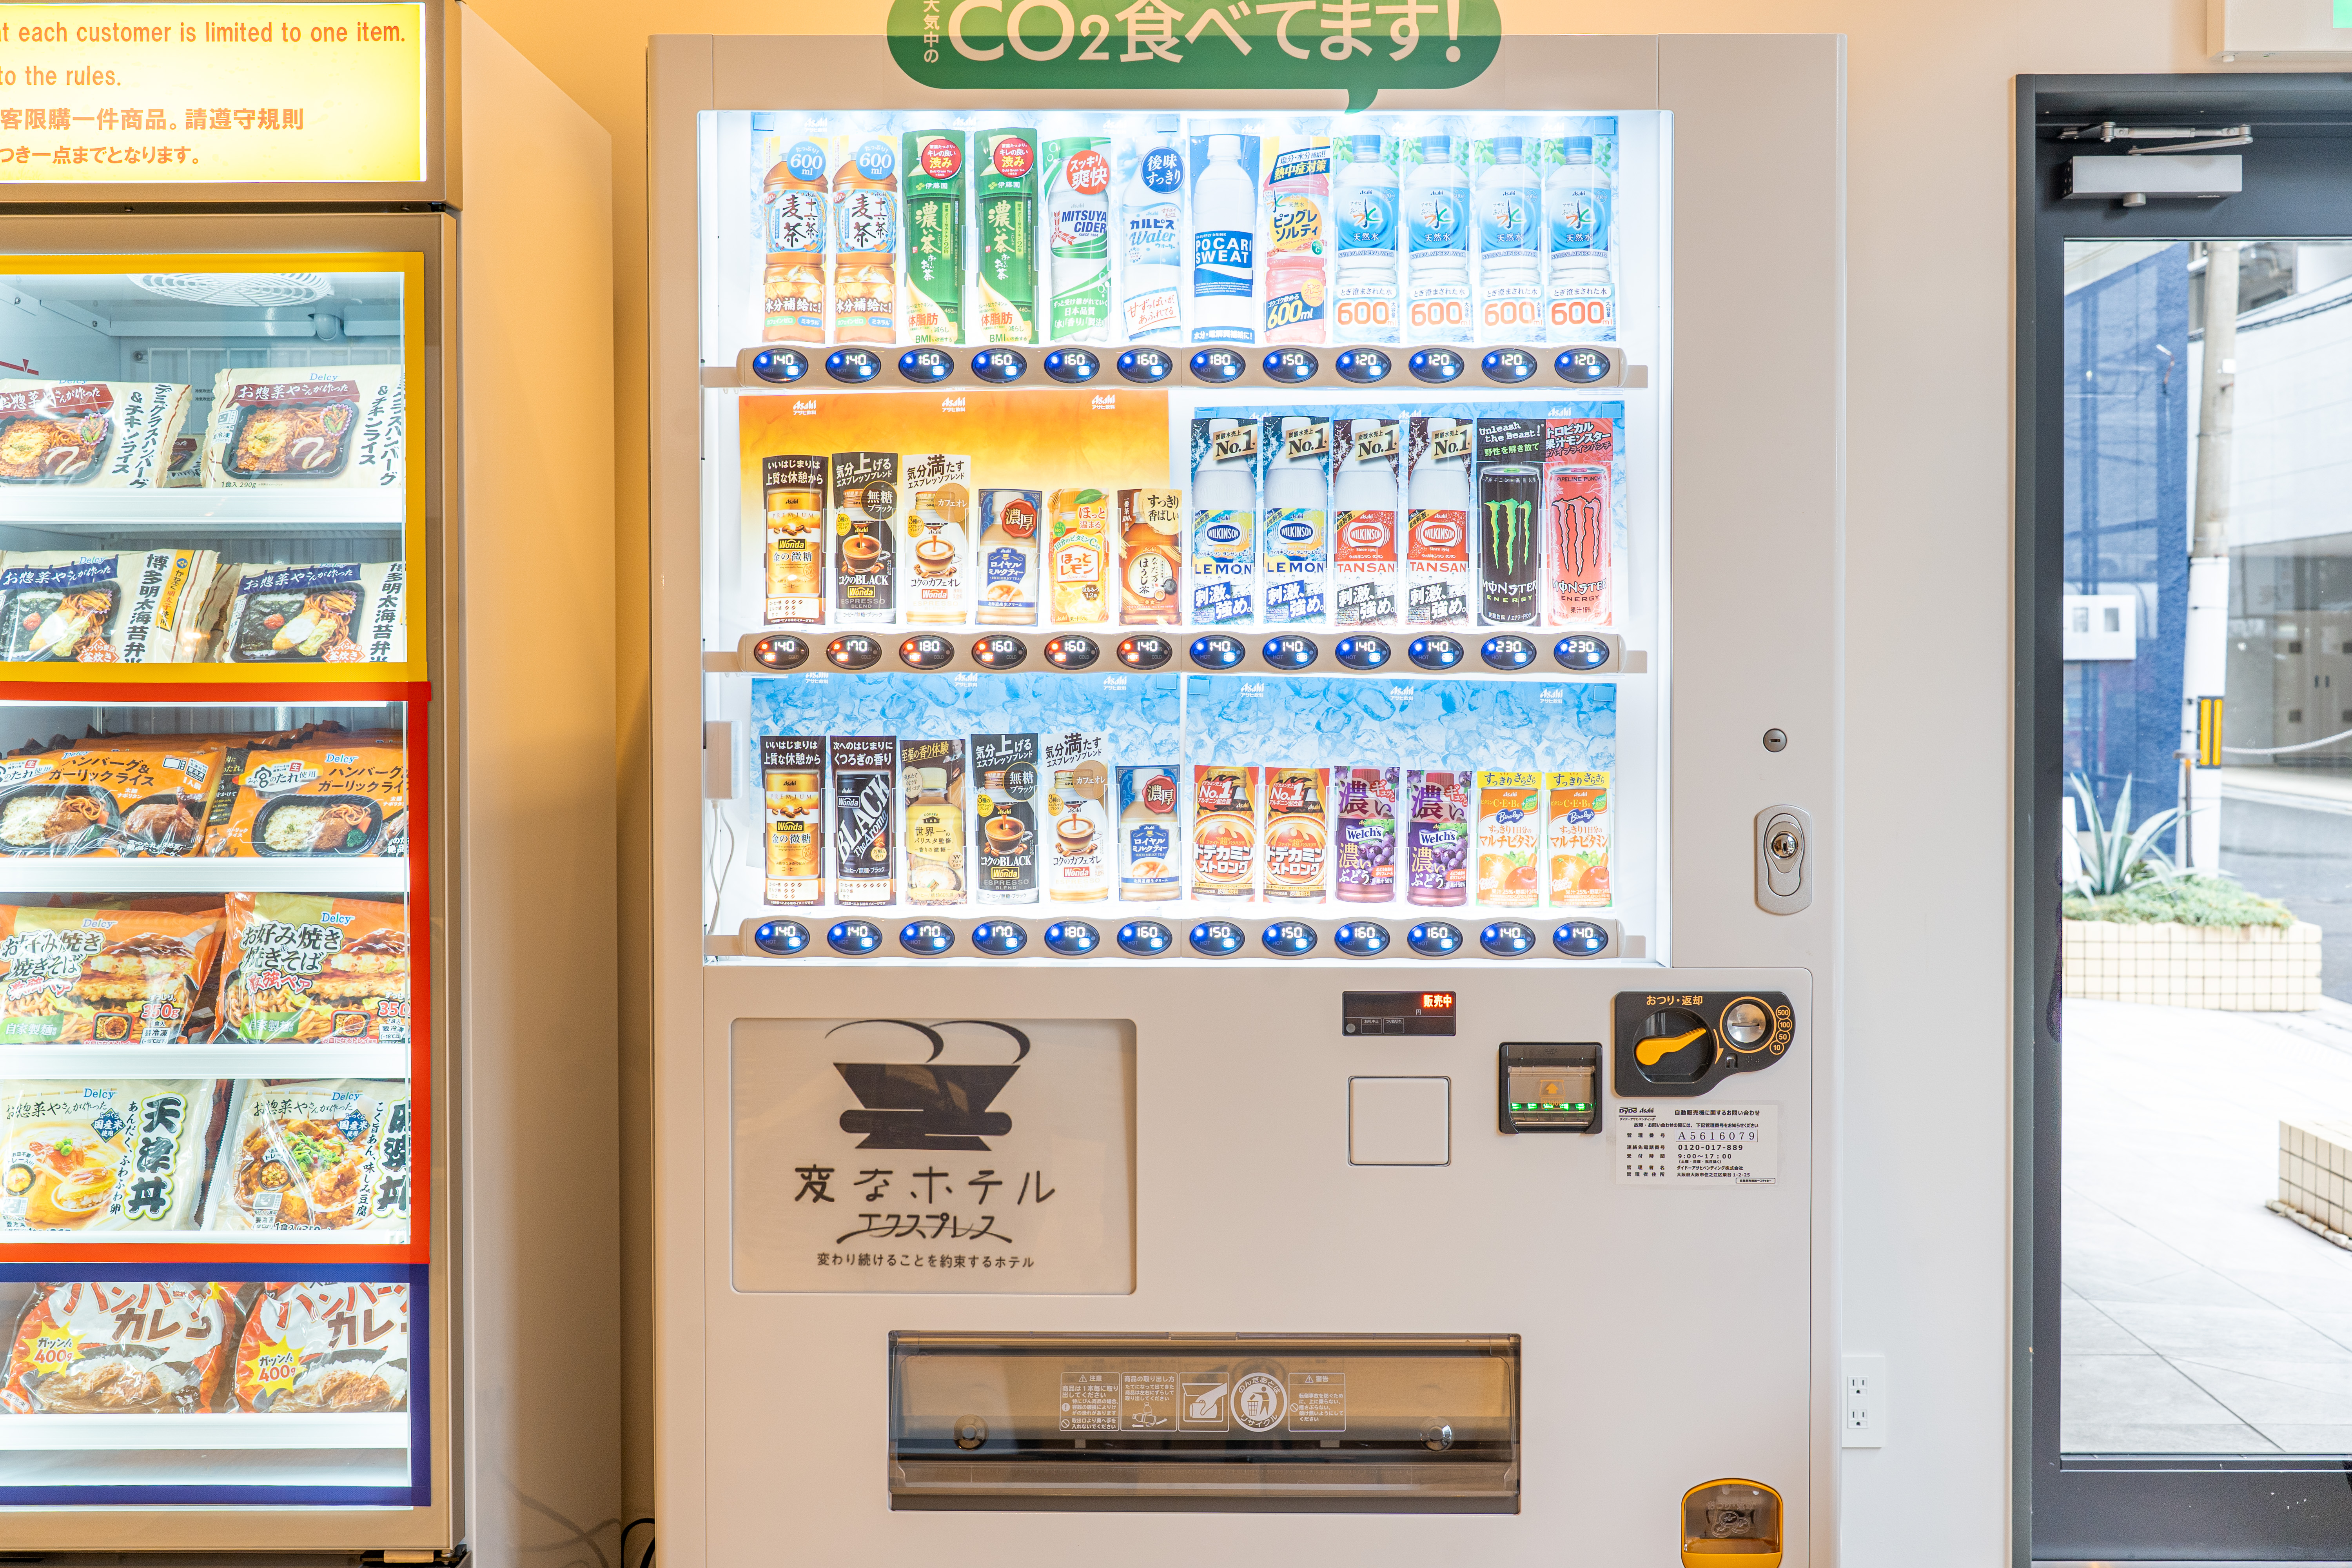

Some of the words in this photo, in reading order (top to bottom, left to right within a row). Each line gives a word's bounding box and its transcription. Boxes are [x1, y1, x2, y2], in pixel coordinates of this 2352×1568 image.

[19, 22, 67, 42] each
[78, 23, 171, 42] customer
[181, 22, 196, 42] is
[207, 22, 272, 42] limited
[282, 23, 301, 42] to
[310, 26, 347, 42] one
[357, 22, 405, 42] item.
[923, 0, 939, 63] 大気中の
[0, 66, 16, 85] to
[25, 66, 56, 85] the
[66, 66, 121, 85] rules.
[791, 154, 823, 169] 600
[860, 152, 892, 168] 600
[929, 157, 952, 169] 渋み
[1070, 154, 1102, 172] スッキリ
[1147, 154, 1177, 171] 後味
[1274, 160, 1326, 181] 熱中症対策
[1072, 167, 1107, 190] 爽快
[1146, 170, 1181, 187] すっきり
[1062, 211, 1107, 223] MITSUYA
[1274, 209, 1317, 228] ピングレ
[1074, 222, 1107, 233] CIDER
[1130, 219, 1174, 230] カルピス
[1129, 230, 1176, 246] Water
[1353, 232, 1379, 241] 天然水
[1196, 238, 1251, 252] POCARI
[1196, 251, 1249, 264] SWEAT
[1553, 288, 1607, 297] とぎ澄まされた水
[765, 297, 821, 313] 水分補給に!
[836, 298, 892, 313] 水分補給に!
[1065, 307, 1095, 316] 日本品質
[908, 313, 938, 327] 体脂肪
[981, 312, 1013, 326] 体脂肪
[310, 373, 338, 381] Delcy
[238, 383, 348, 400] お惣菜やさんが作った
[793, 400, 816, 410] Asahi
[1479, 422, 1521, 436] Unleash
[1547, 422, 1593, 438] トロピカル
[1486, 434, 1504, 443] the
[1546, 433, 1610, 450] 果汁モンスター
[1485, 443, 1539, 457] 野性を解き放て
[768, 460, 820, 469] いいはじまりは
[766, 472, 823, 486] 上質な休憩から
[867, 490, 893, 504] 無糖
[1147, 494, 1179, 510] すっきり
[867, 505, 893, 513] ブラック
[1148, 509, 1179, 522] 香ばしい
[1005, 508, 1034, 530] 濃厚
[1208, 528, 1238, 539] WILKINSON
[1351, 530, 1381, 540] WILKINSON
[779, 540, 804, 549] Wonda
[773, 552, 812, 562] 金の微糖
[1060, 564, 1094, 575] レモン
[1195, 564, 1251, 574] LEMON
[1338, 563, 1394, 572] TANSAN
[3, 565, 111, 586] お惣菜やさんが作った
[244, 569, 353, 590] お惣菜やさんが作った
[838, 575, 889, 586] コクのBLACK
[1139, 557, 1150, 594] ほうじ茶
[833, 742, 893, 750] 次へのはじまりに
[902, 741, 949, 762] 至福の香り体験
[325, 754, 354, 764] Delcy
[834, 753, 892, 766] くつろぎの香り
[1076, 775, 1106, 785] カフェオレ
[1348, 828, 1381, 840] Welch's
[1479, 835, 1537, 848] マルチビタミン
[1053, 856, 1102, 866] コクのカフェオレ
[1200, 860, 1247, 874] ストロング
[1339, 869, 1370, 884] ぶどう
[82, 919, 114, 929] Delcy
[321, 913, 351, 925] Delcy
[243, 923, 339, 950] お好み焼き
[243, 947, 324, 973] 焼きそば
[1424, 995, 1452, 1007] 販売中
[1646, 995, 1703, 1005] おつり・返却
[84, 1089, 114, 1100] Delcy
[332, 1092, 360, 1101] Delcy
[7, 1101, 107, 1120] お惣菜やさんが作った
[254, 1099, 352, 1116] お惣菜やさんが作った
[94, 1120, 124, 1130] 国産米
[340, 1120, 369, 1131] 国産米
[128, 1097, 181, 1214] 天津丼
[794, 1164, 1056, 1205] 変なホテル
[858, 1213, 995, 1240] エクスプレス
[817, 1252, 1034, 1268] 変わり続けることを約束するホテル
[258, 1364, 295, 1383] 400g
[1239, 1377, 1280, 1394] のんだあとは
[1241, 1414, 1277, 1428] リサイクル
